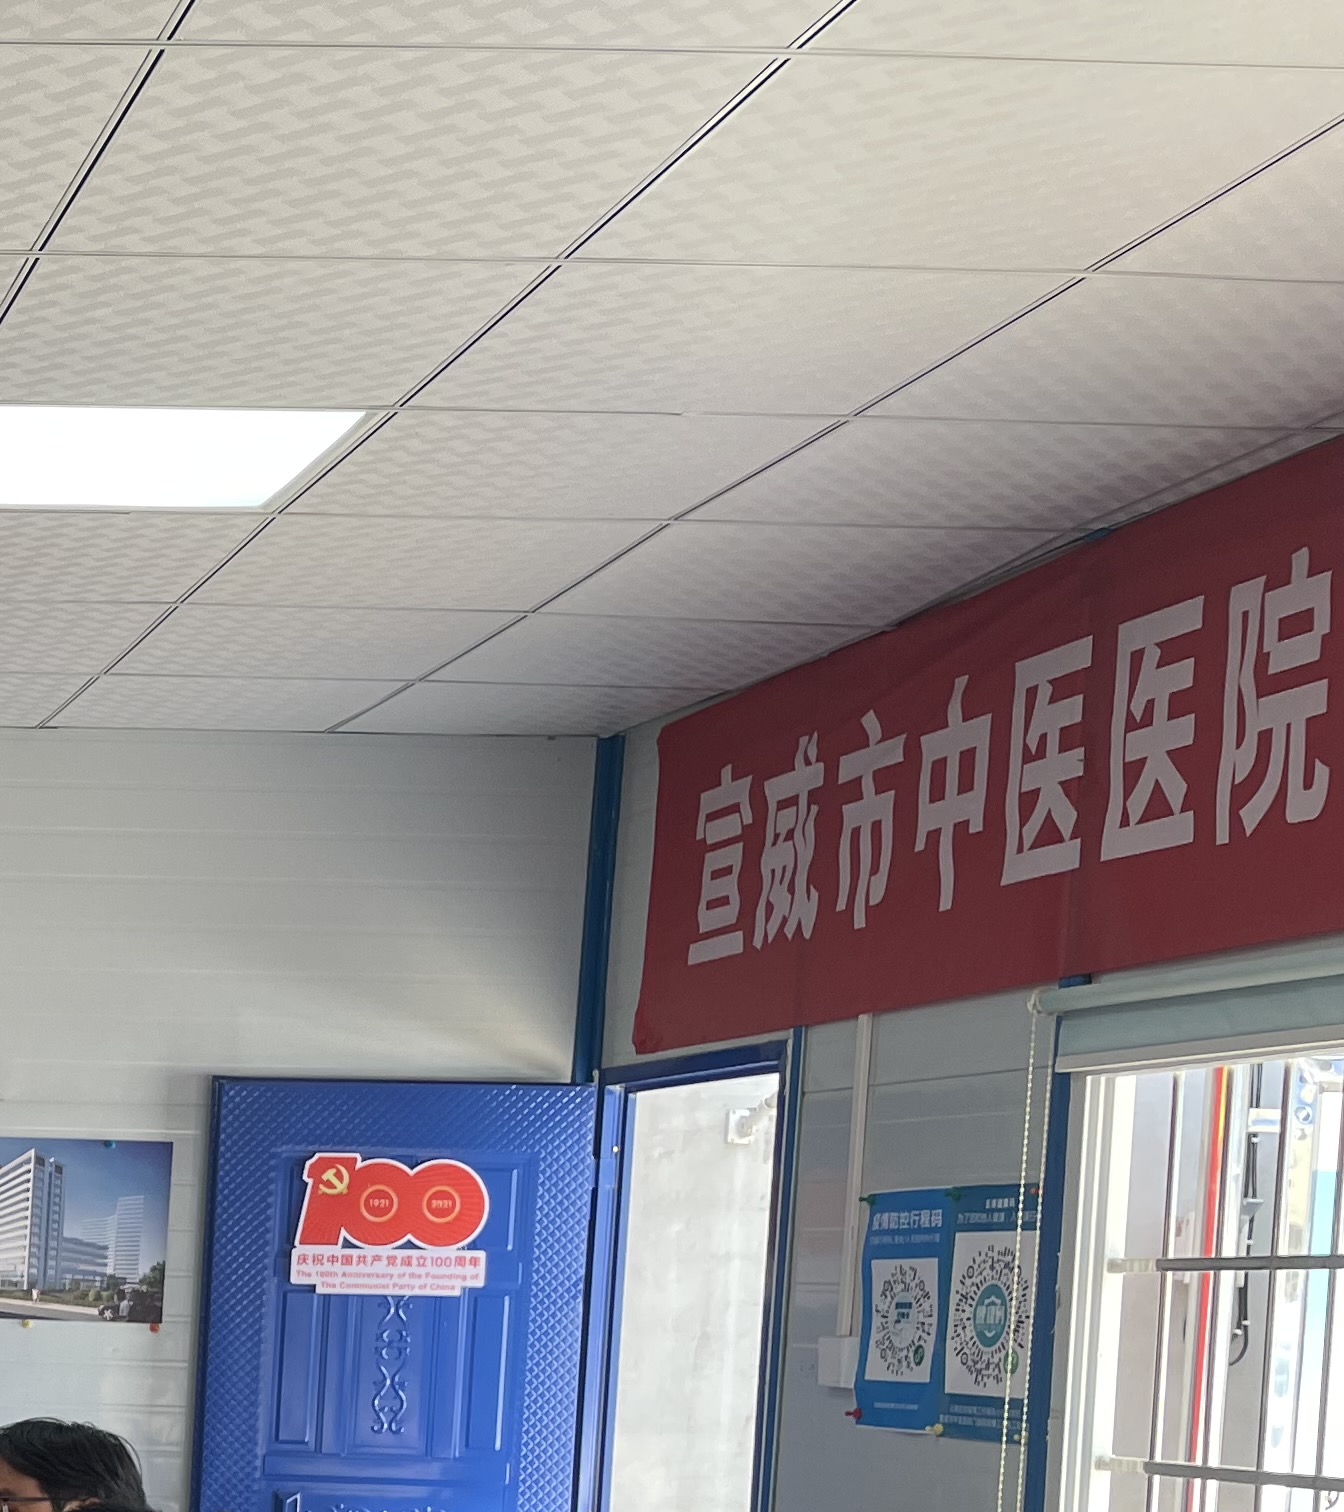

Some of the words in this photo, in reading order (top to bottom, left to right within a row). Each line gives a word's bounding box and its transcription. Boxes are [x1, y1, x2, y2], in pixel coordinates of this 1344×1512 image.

[687, 546, 1332, 966] 宣威市中医医院
[369, 1198, 389, 1208] 1921
[431, 1199, 452, 1209] 2021
[296, 1254, 481, 1268] 庆祝中国共产党成立100周年
[296, 1269, 312, 1278] The
[341, 1271, 394, 1280] Anniversary
[397, 1271, 406, 1279] of
[408, 1271, 422, 1279] the
[425, 1272, 467, 1282] Founding
[470, 1273, 479, 1281] of
[320, 1281, 336, 1289] The
[340, 1281, 389, 1290] Communist
[393, 1283, 414, 1293] Party
[429, 1284, 456, 1292] China
